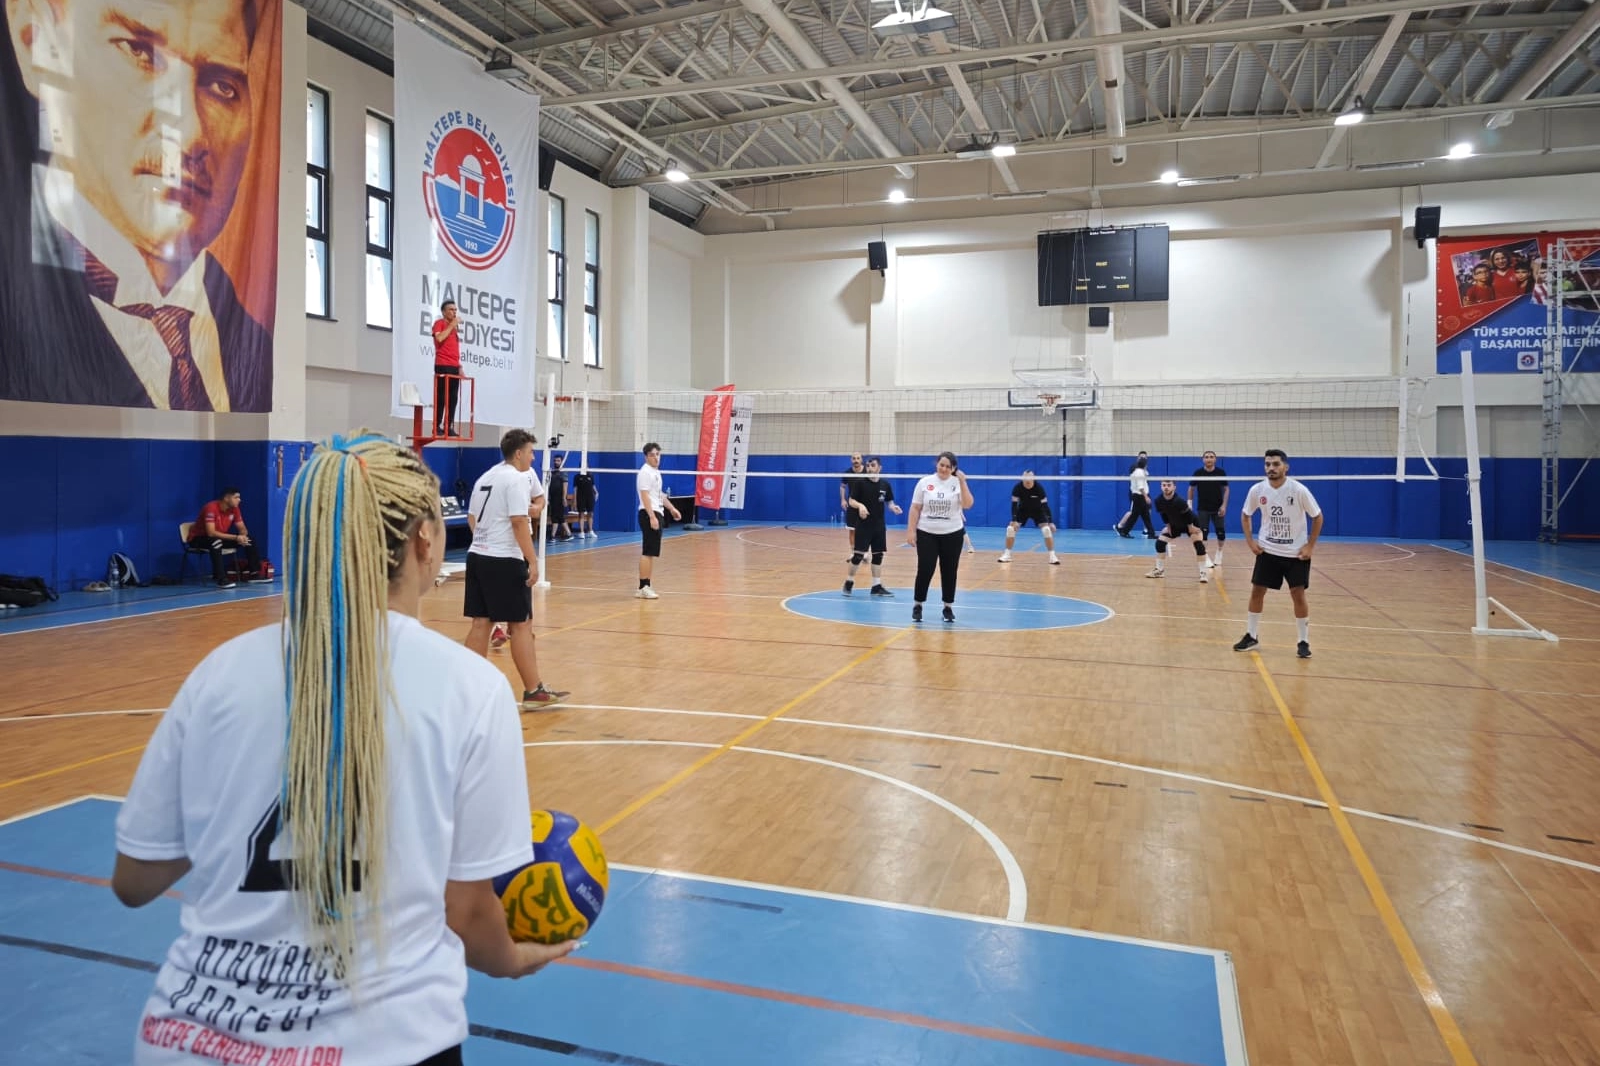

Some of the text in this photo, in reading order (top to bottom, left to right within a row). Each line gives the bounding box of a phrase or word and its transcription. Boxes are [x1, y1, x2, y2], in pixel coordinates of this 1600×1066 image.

[423, 110, 463, 169] MALTEPE
[421, 274, 516, 325] MALTEPE
[1472, 326, 1499, 337] TÜM
[477, 485, 493, 523] 7
[1271, 505, 1283, 516] 23
